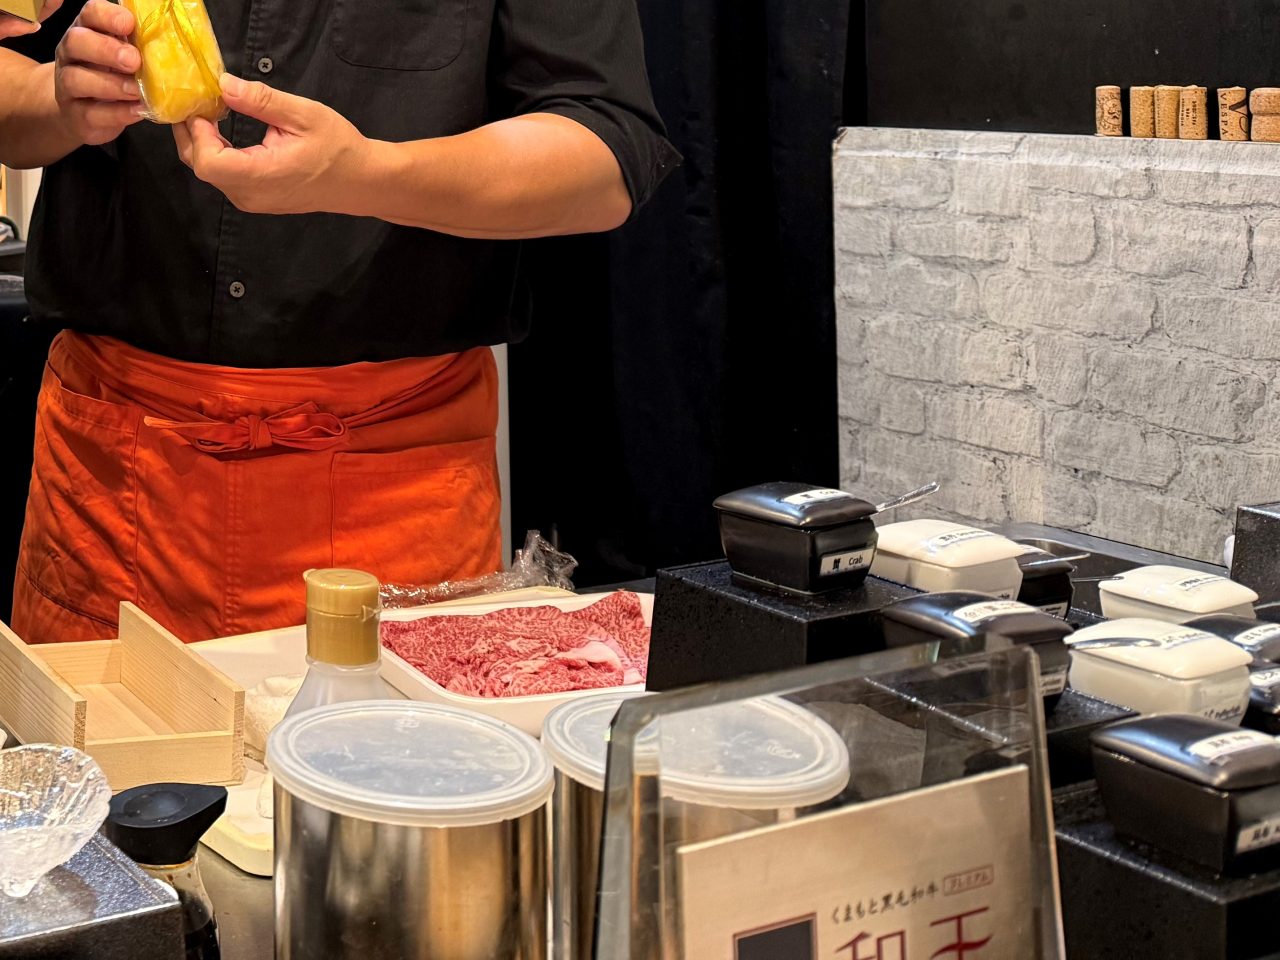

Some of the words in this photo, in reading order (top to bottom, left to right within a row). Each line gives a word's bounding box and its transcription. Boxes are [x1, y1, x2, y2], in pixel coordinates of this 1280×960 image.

[848, 555, 864, 566] Crab
[831, 880, 940, 925] くまもと黒毛和牛
